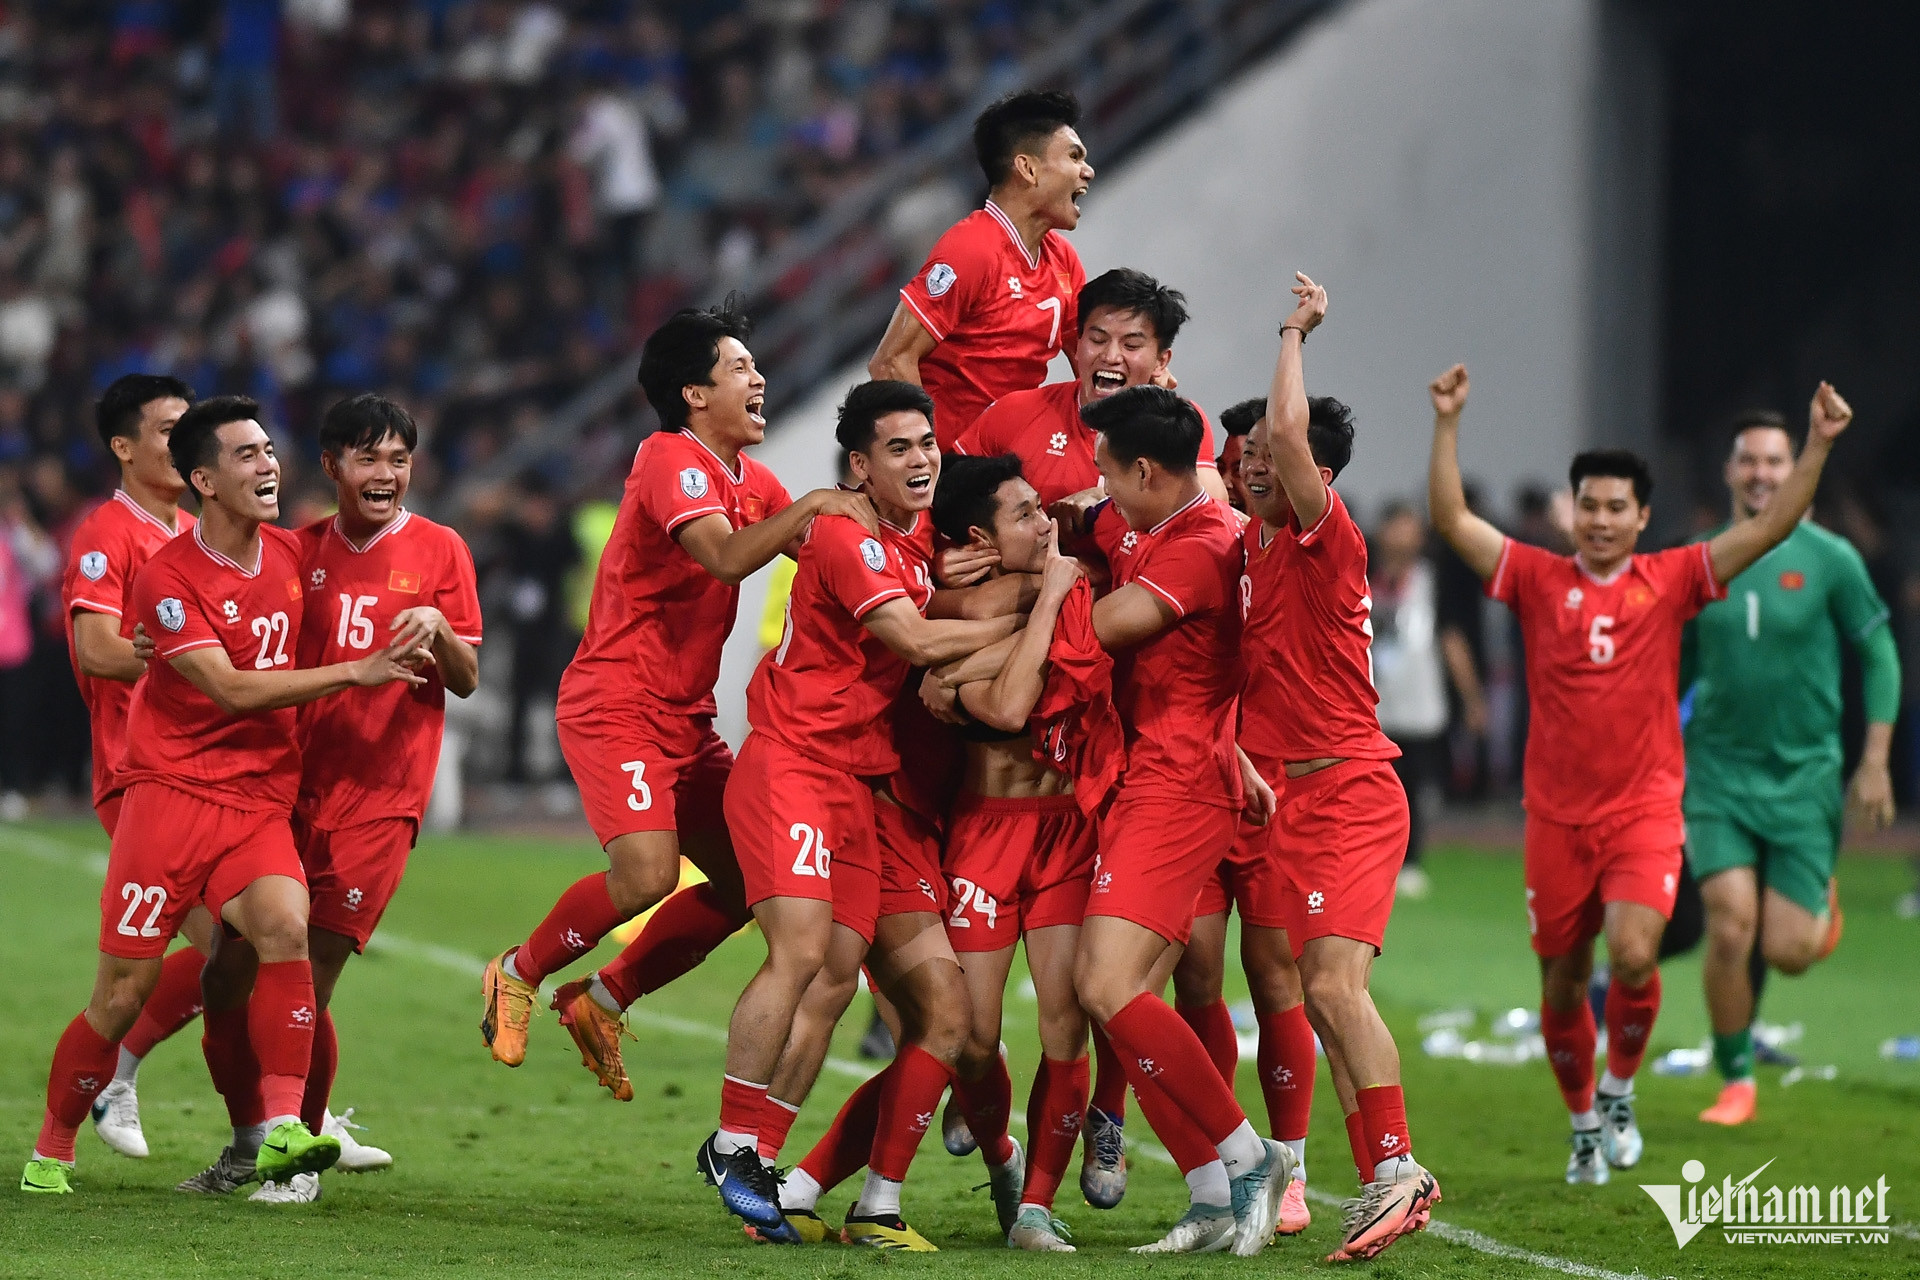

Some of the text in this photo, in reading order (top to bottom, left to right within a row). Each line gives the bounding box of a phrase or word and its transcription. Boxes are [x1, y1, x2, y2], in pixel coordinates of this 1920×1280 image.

[1036, 296, 1061, 349] 7
[251, 611, 290, 670] 22
[337, 593, 379, 650] 15
[1588, 615, 1615, 664] 5
[1745, 591, 1759, 640] 1
[620, 760, 652, 811] 3
[789, 822, 831, 880] 26
[117, 882, 168, 938] 22
[949, 877, 997, 930] 24
